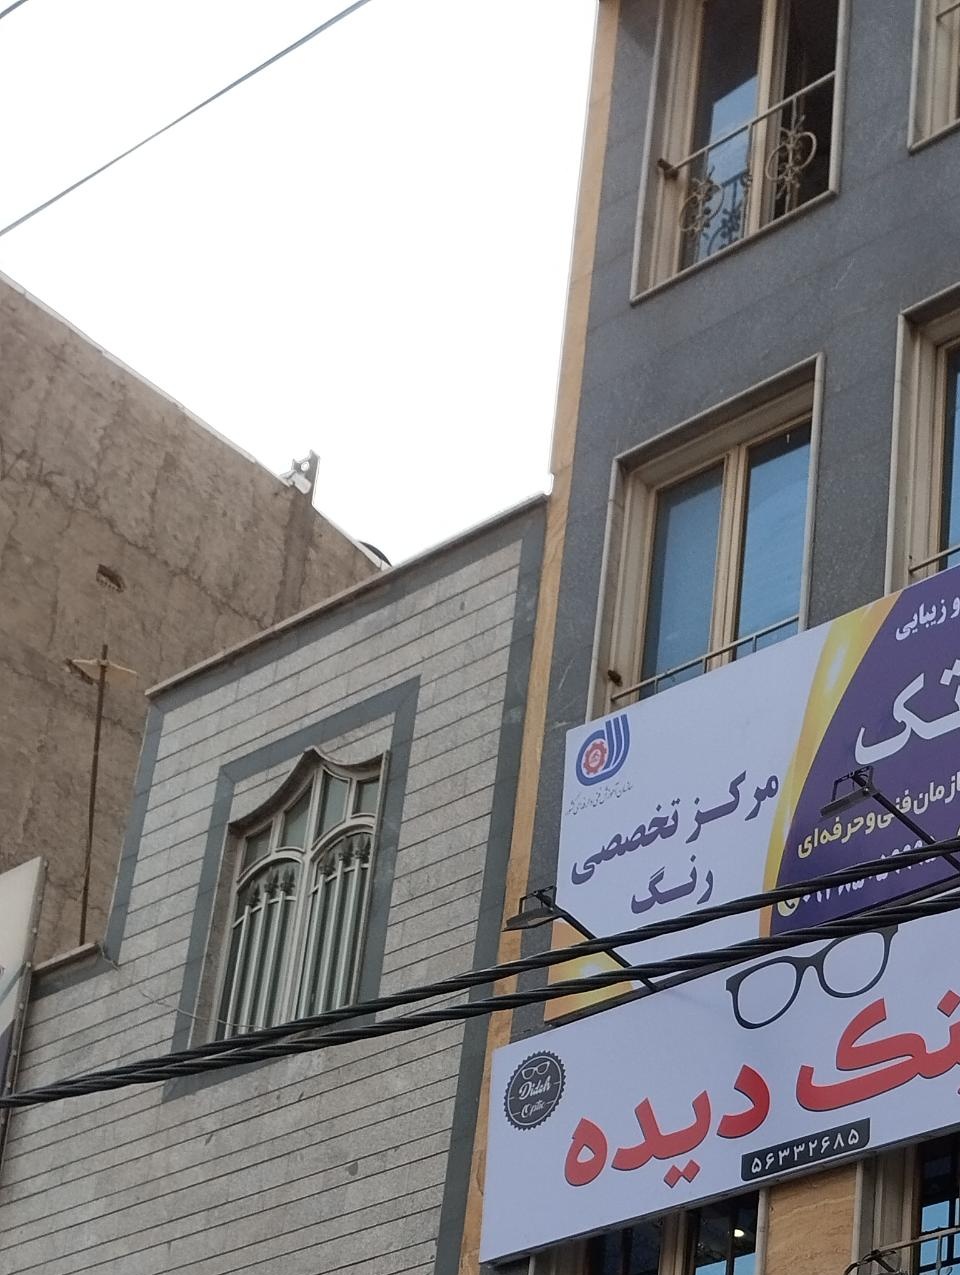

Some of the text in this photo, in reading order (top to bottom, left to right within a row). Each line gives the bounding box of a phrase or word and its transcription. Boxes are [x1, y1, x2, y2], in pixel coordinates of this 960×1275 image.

[895, 597, 947, 641] زیبایی
[951, 595, 960, 618] و
[686, 770, 779, 844] مرکز
[865, 812, 874, 835] و
[571, 797, 680, 885] تخصصی
[630, 854, 714, 915] رنگ
[564, 1064, 771, 1189] دیده
[751, 1129, 860, 1174] ۵۶۳۳۲۶۸۵
